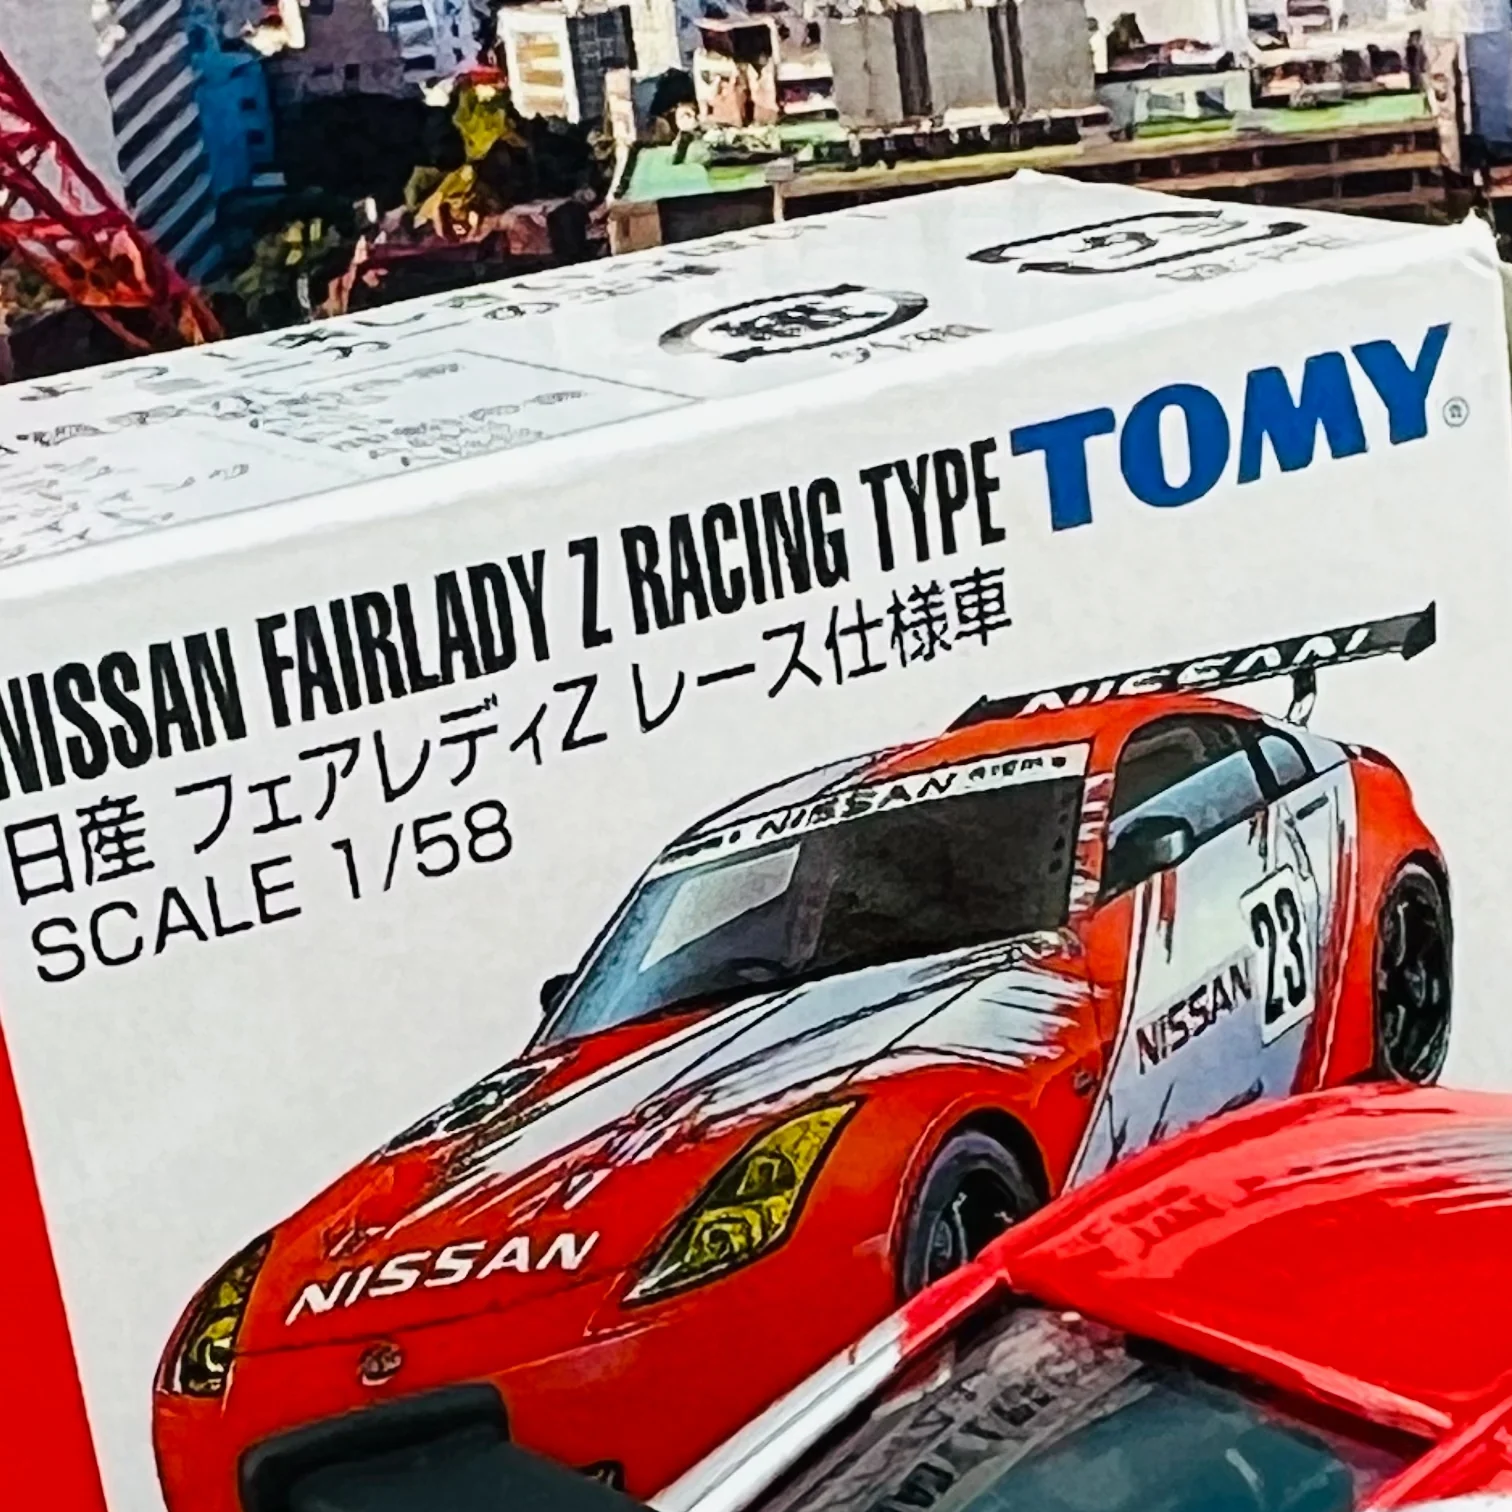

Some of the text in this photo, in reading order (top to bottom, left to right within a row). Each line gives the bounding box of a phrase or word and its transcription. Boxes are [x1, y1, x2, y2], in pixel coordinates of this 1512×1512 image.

[1010, 323, 1451, 532] TOMY
[0, 437, 1005, 799] NISSAN FAIRLADY Z RACING TYPE
[4, 567, 1011, 905] 日産 フェアレディZ レース仕様車
[32, 800, 511, 982] SCALE 1/58
[1250, 888, 1307, 1025] 23
[1136, 963, 1252, 1075] NISSAN
[285, 1231, 600, 1326] NISSAN
